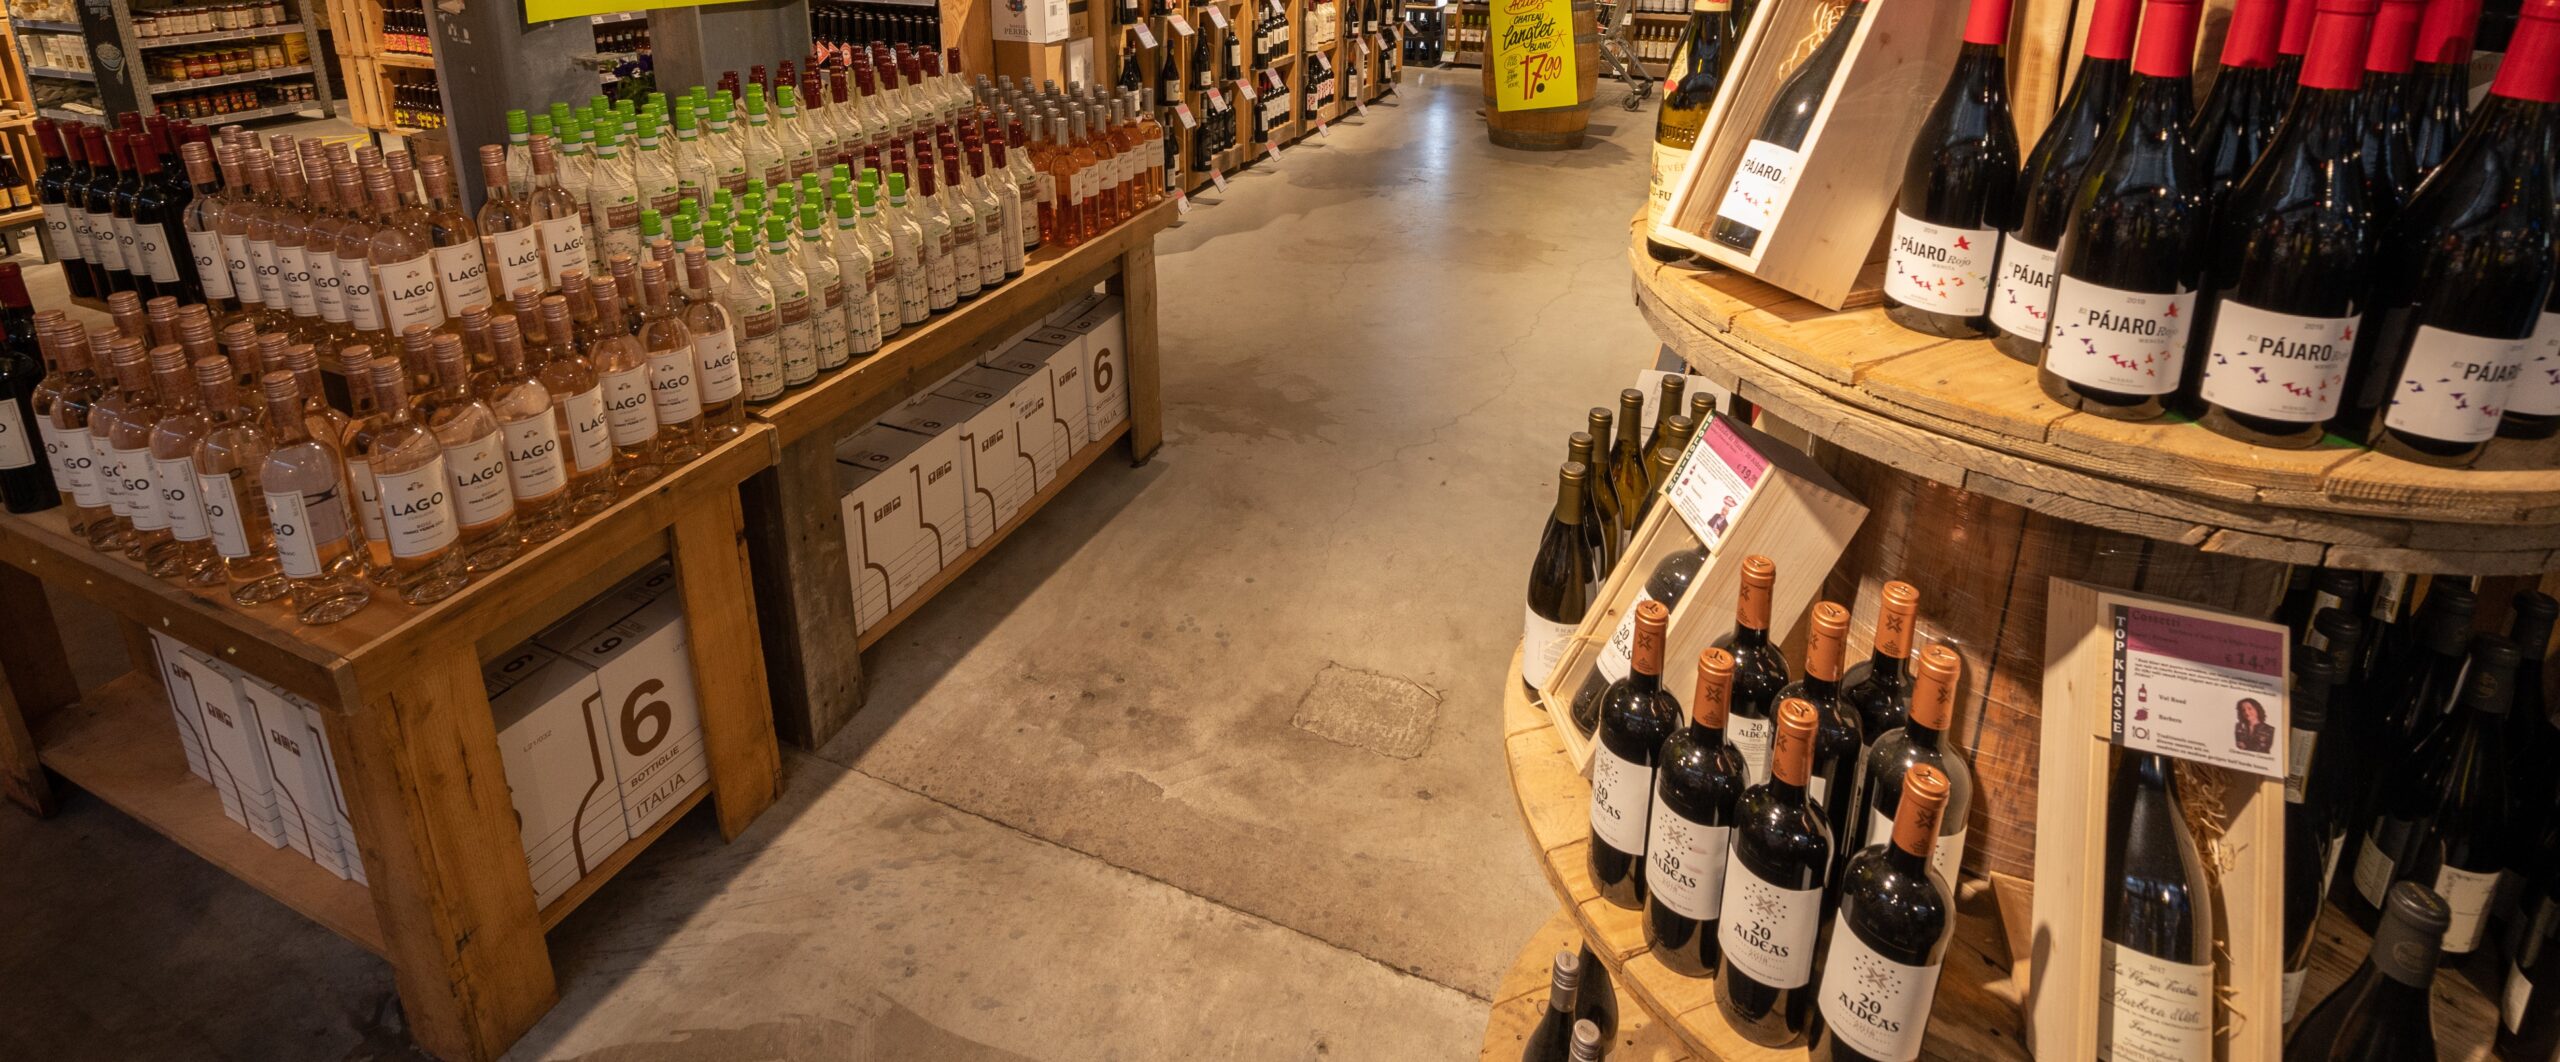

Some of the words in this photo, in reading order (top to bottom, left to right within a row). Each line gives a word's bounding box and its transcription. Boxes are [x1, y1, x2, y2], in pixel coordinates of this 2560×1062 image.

[1513, 12, 1544, 24] CHATEAU
[1529, 41, 1552, 52] BLANC
[1742, 157, 1782, 183] PÁJARO
[1901, 231, 1946, 263] PÁJARO
[1946, 255, 1972, 268] Rojo
[392, 280, 435, 302] LAGO
[2087, 309, 2156, 337] PÁJARO
[2258, 336, 2333, 362] PÁJARO
[650, 374, 690, 392] LAGO
[1093, 347, 1114, 394] 6
[605, 392, 648, 412] LAGO
[579, 411, 607, 434] LAG
[509, 439, 556, 463] LAGO
[457, 461, 504, 487] LAGO
[391, 491, 444, 517] LAGO
[2115, 615, 2127, 652] TOP
[2112, 658, 2126, 734] KLASSE
[620, 677, 673, 757] 6
[1751, 722, 1764, 733] 20
[1738, 729, 1768, 739] ALDEA
[630, 743, 681, 789] BOTTIGLIE
[635, 772, 687, 820] ITALIA
[1651, 851, 1698, 889] ALDEAS
[1662, 849, 1681, 871] 20
[1733, 922, 1790, 959] ALDEAS
[1750, 921, 1772, 941] 20
[1838, 991, 1901, 1035] ALDEAS
[1858, 991, 1883, 1015] 20
[2114, 987, 2166, 1018] Barbera
